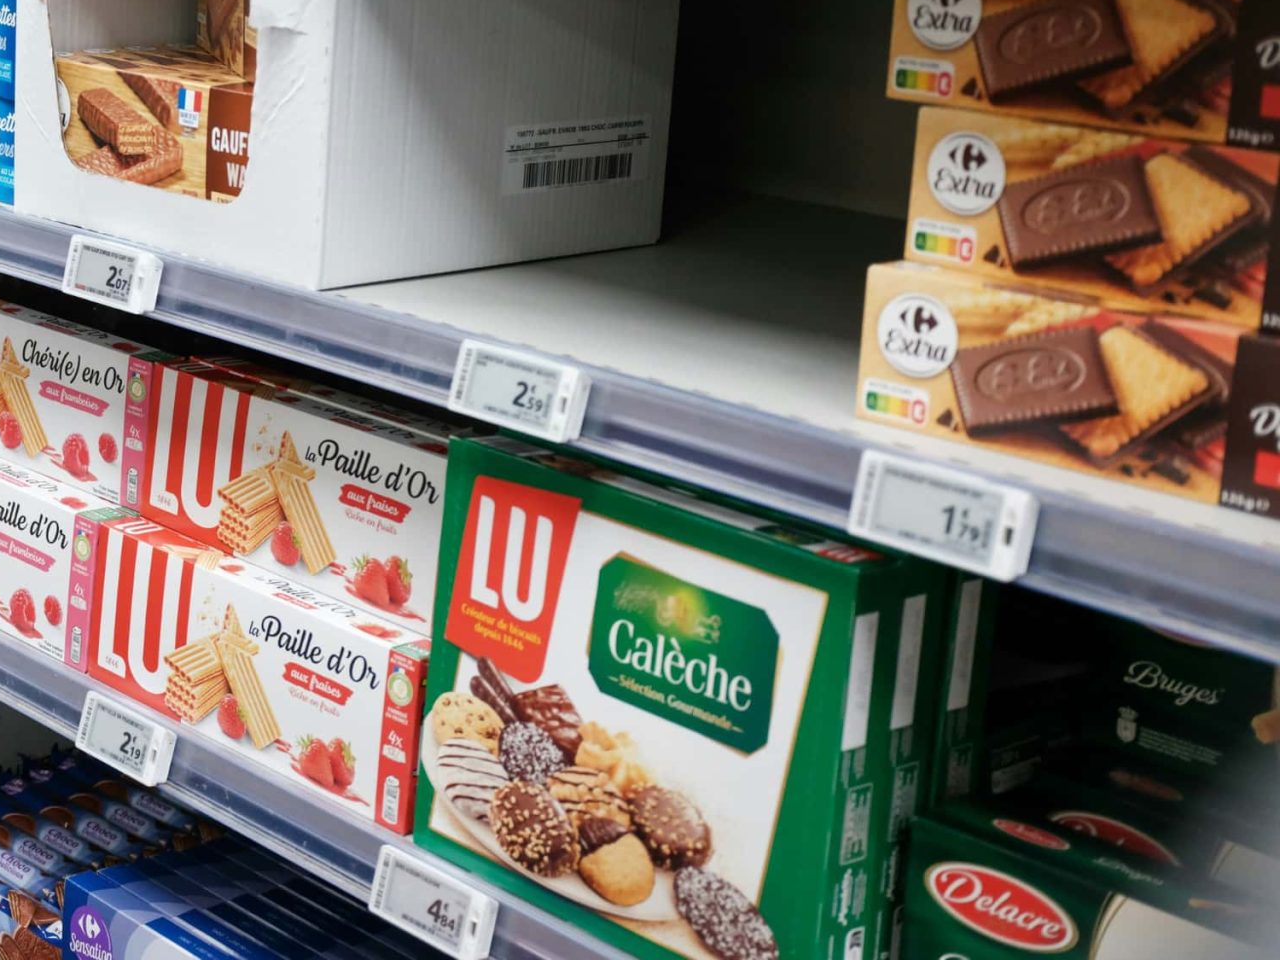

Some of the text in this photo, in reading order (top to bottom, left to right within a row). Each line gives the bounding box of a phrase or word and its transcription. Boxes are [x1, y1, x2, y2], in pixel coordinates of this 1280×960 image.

[913, 3, 974, 36] Extra
[934, 167, 996, 200] Extra
[884, 328, 949, 364] Extra
[22, 339, 125, 394] Chéri(e) en Or
[46, 386, 100, 413] aux framboises
[149, 361, 250, 529] LU
[305, 439, 440, 505] la Paille d'Or
[347, 491, 400, 516] aux fraises
[30, 514, 69, 550] d'Or
[9, 540, 46, 567] framboises
[470, 494, 553, 622] LU
[97, 526, 185, 696] LU
[474, 623, 502, 641] depuis
[497, 618, 509, 631] de
[509, 622, 541, 645] biscuits
[249, 615, 380, 690] la Paille d'Or
[608, 619, 752, 712] Calèche
[290, 669, 342, 699] aux fraises
[1124, 660, 1221, 706] Bruges
[618, 674, 733, 730] Sélection Gourmande
[0, 851, 32, 874] Choco
[22, 839, 54, 862] Choco
[941, 868, 1061, 940] Delacre
